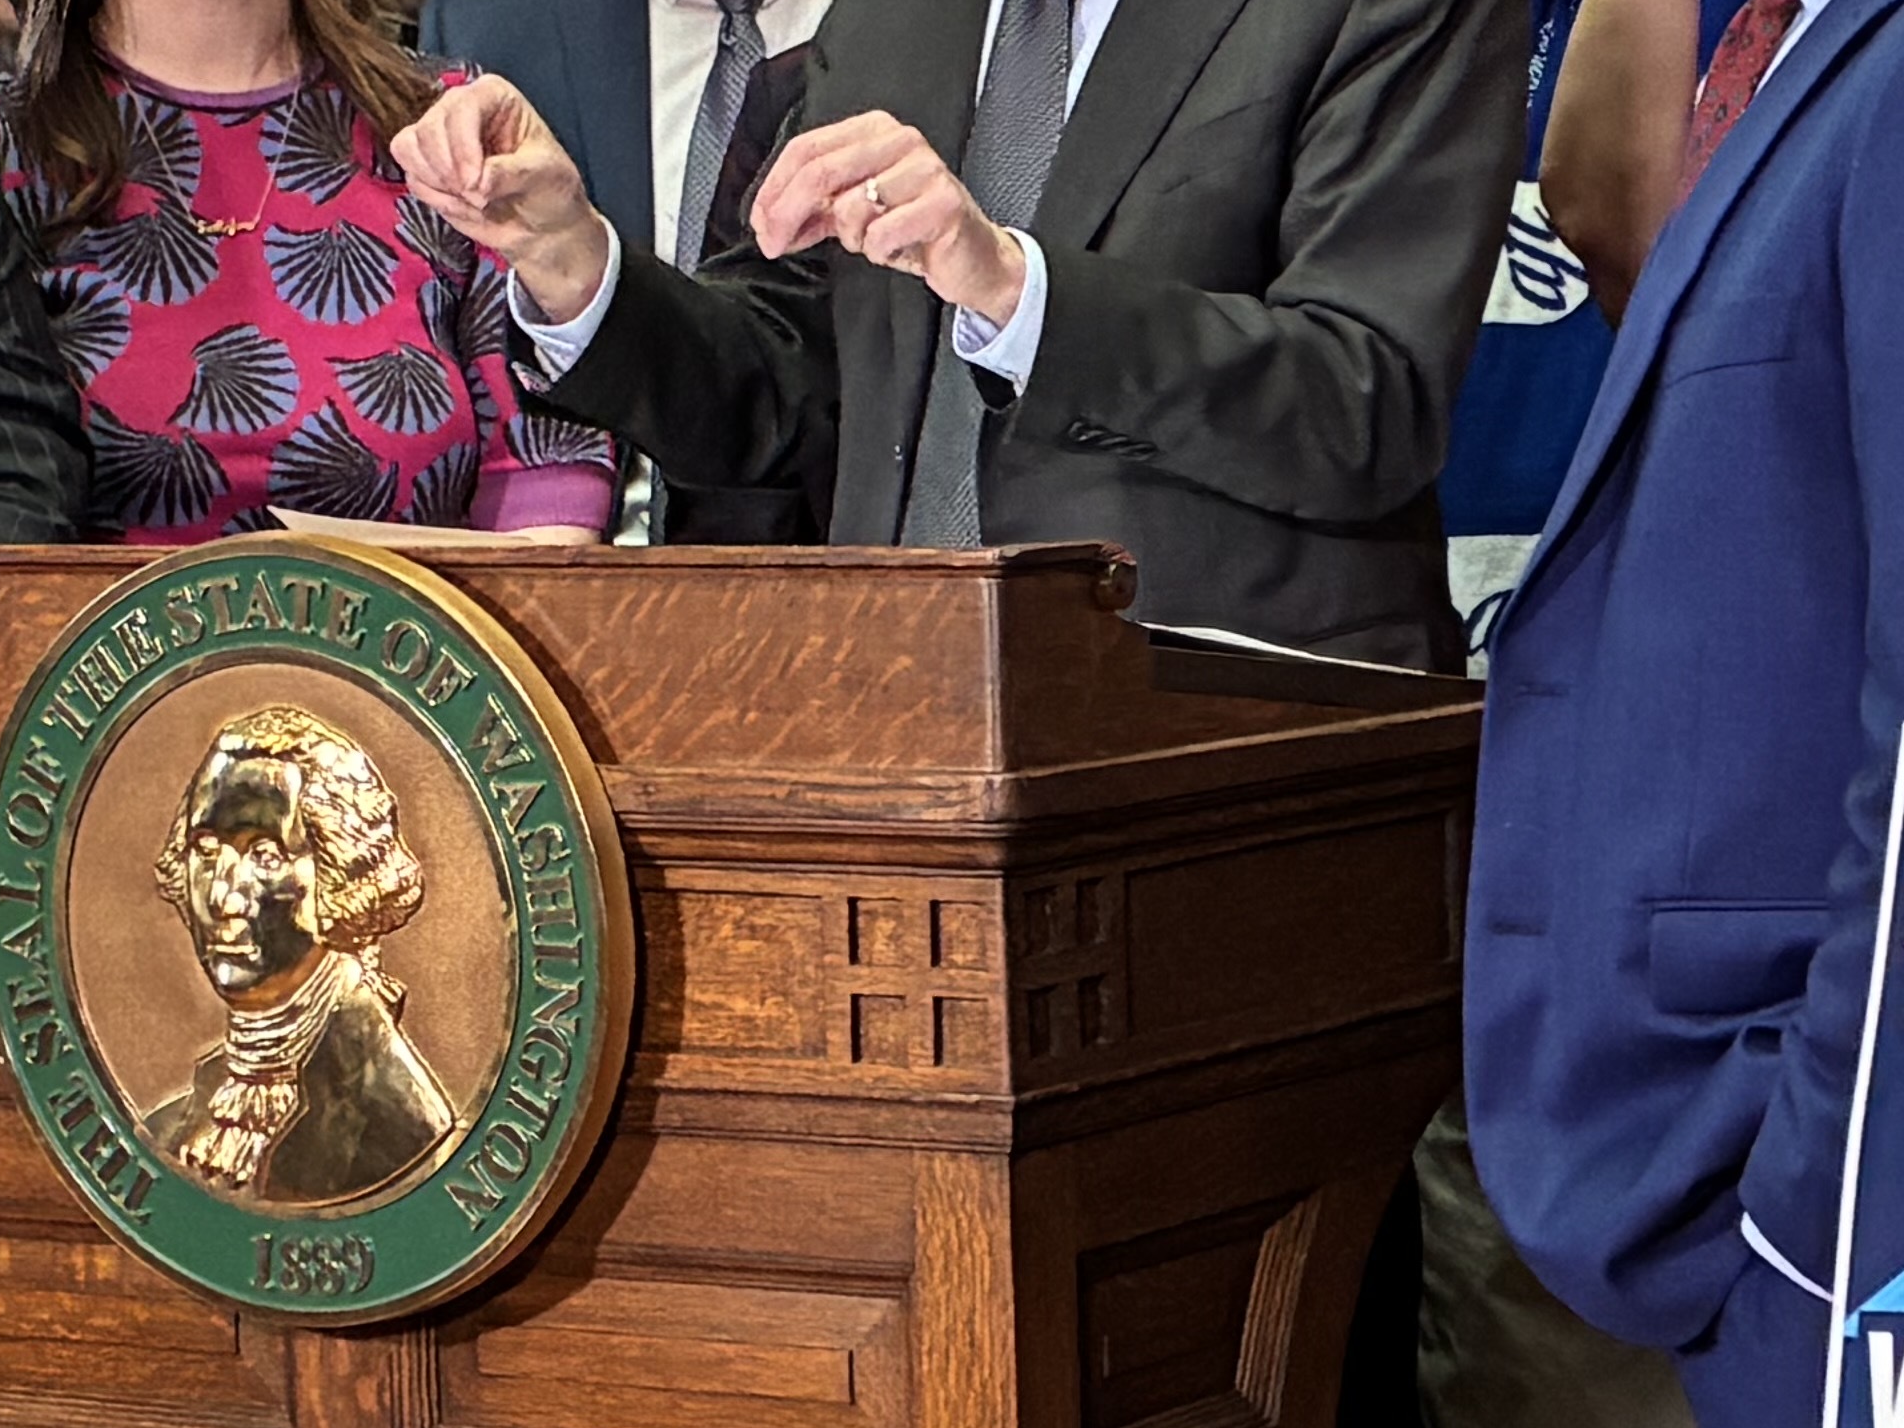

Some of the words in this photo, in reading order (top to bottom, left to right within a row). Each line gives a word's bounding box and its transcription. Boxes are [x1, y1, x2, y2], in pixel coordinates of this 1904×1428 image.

[165, 570, 371, 650] STATE
[380, 618, 478, 706] OF
[41, 607, 166, 742] THE
[6, 735, 67, 850] OF
[444, 692, 585, 1232] WASHINGTON
[46, 1070, 161, 1227] THE
[249, 1233, 377, 1297] 1889
